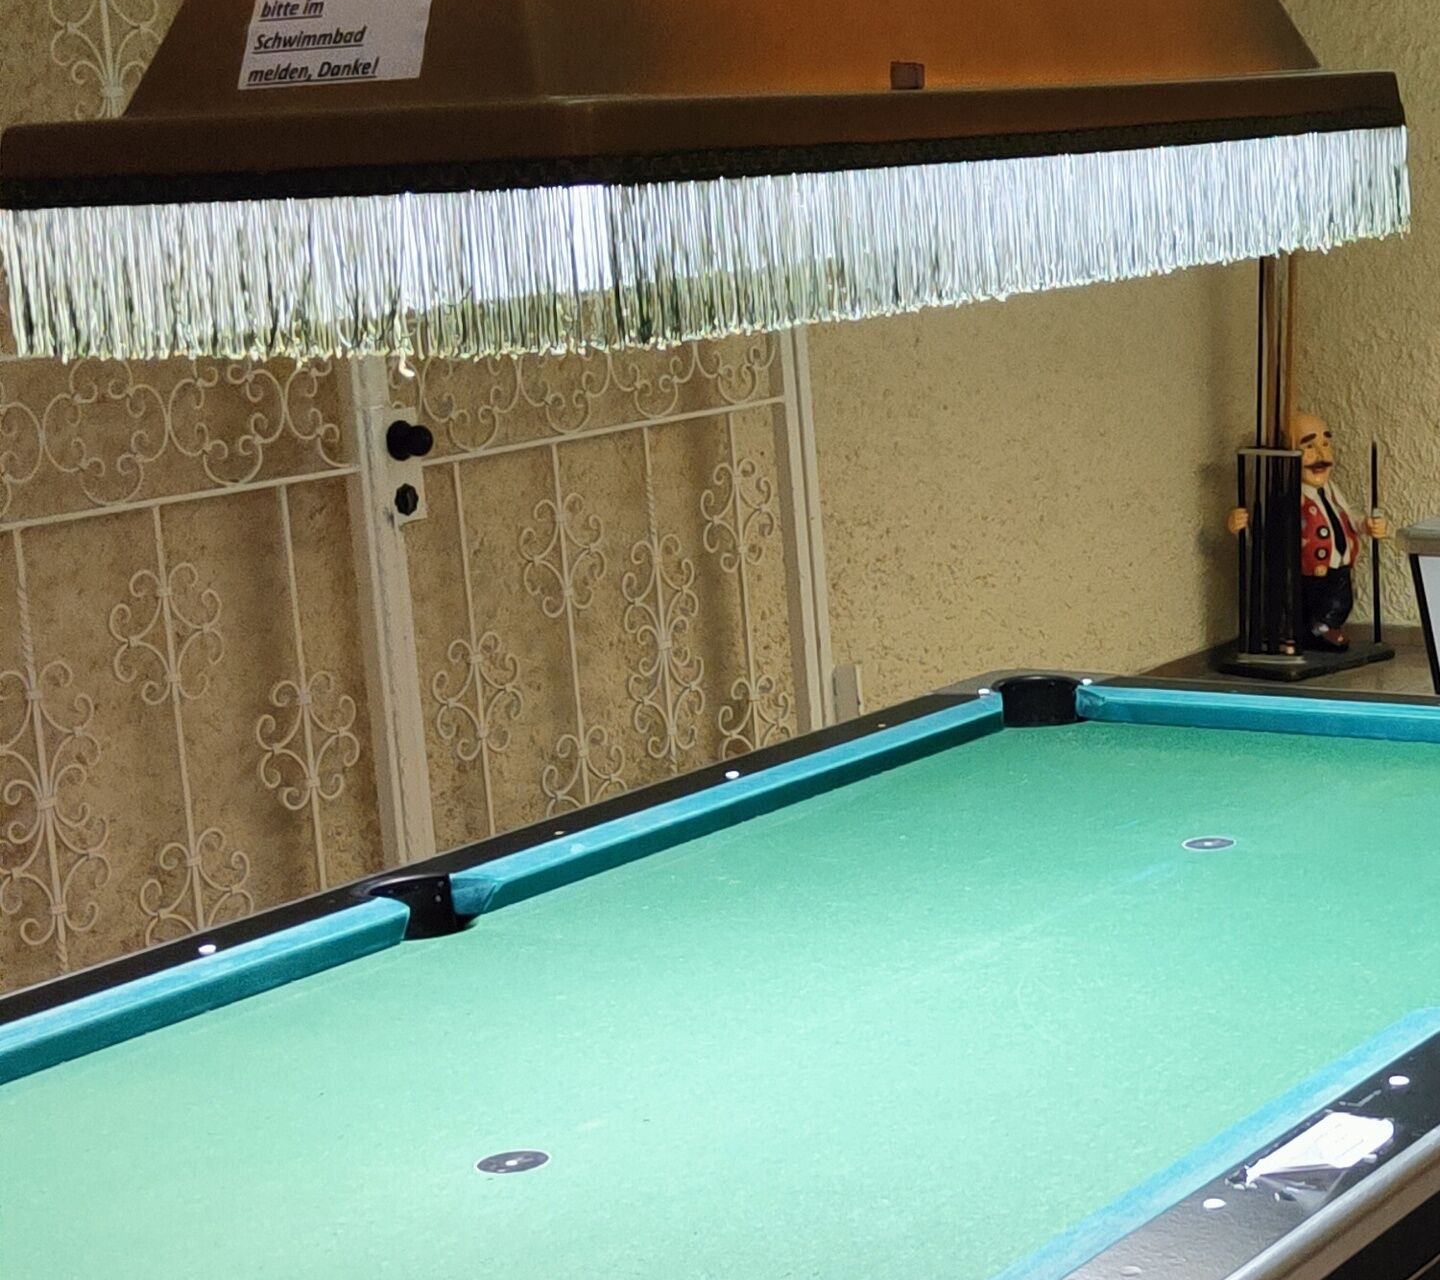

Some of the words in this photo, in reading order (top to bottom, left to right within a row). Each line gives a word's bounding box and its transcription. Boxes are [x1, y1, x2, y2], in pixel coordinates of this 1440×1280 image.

[260, 0, 299, 17] bitte
[302, 0, 324, 15] im
[254, 25, 367, 51] Schwimmbad
[247, 63, 312, 82] melden,
[317, 57, 379, 78] Danke!
